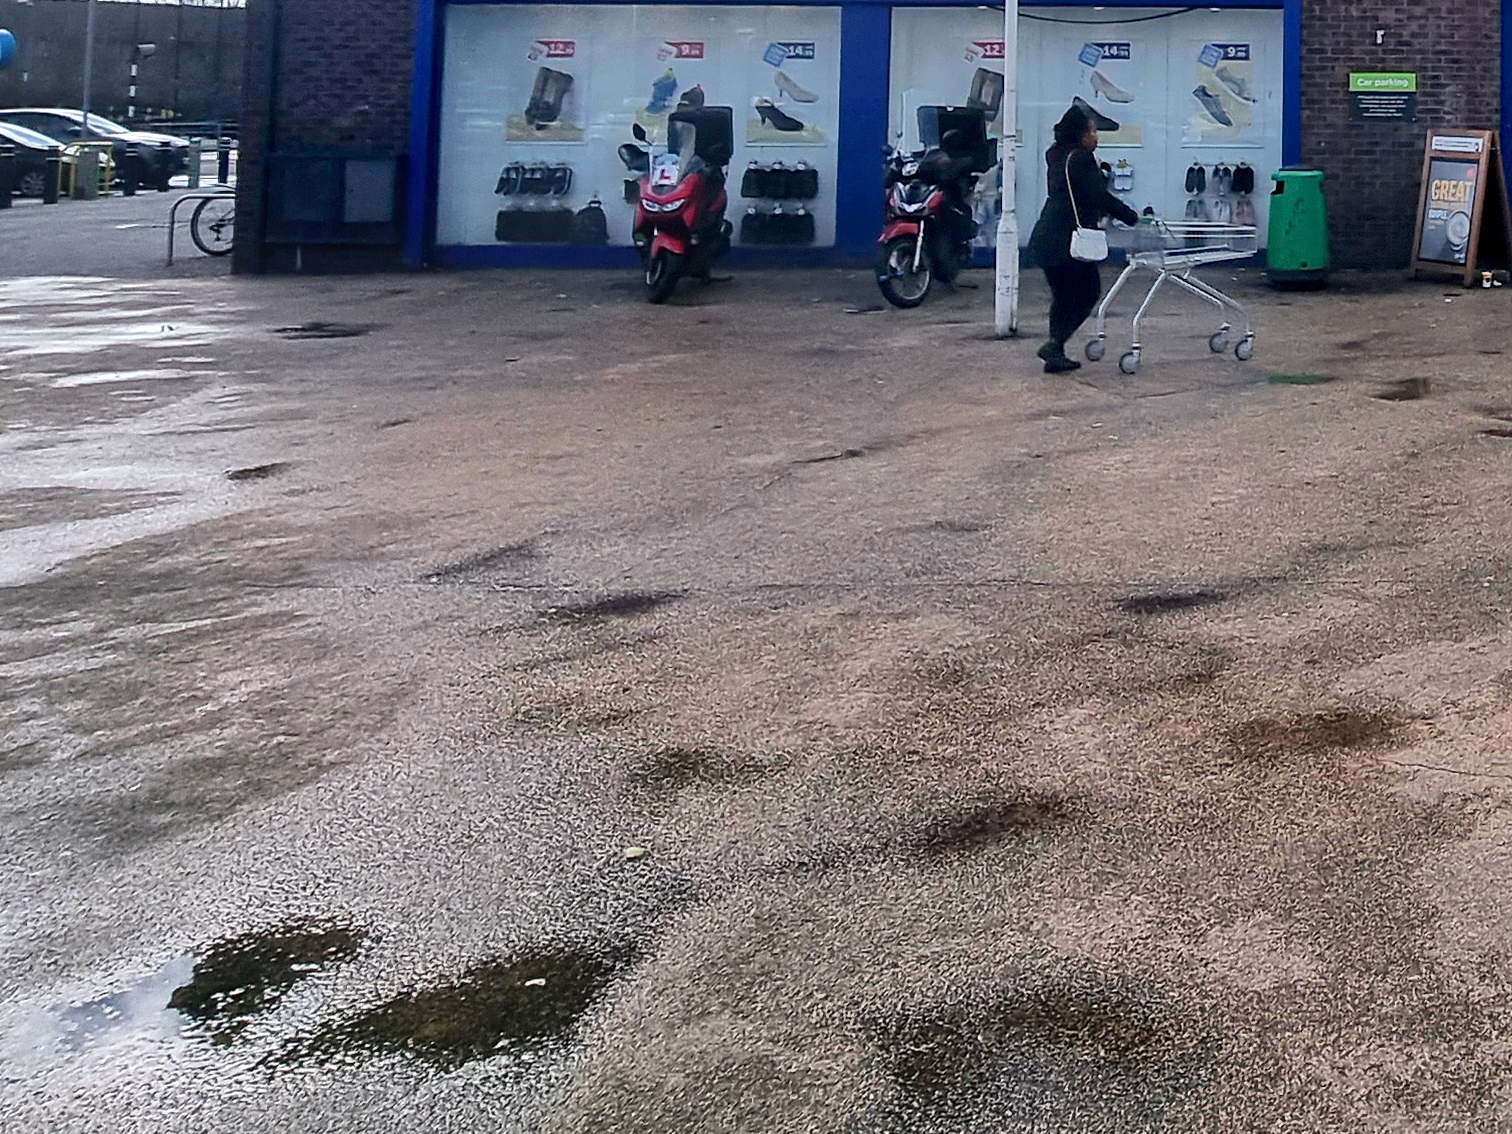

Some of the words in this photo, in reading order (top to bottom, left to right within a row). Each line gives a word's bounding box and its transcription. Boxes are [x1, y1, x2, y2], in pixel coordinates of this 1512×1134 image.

[1357, 78, 1372, 86] Car
[1374, 77, 1409, 87] parking
[660, 169, 671, 180] L
[1431, 179, 1472, 202] GREAT
